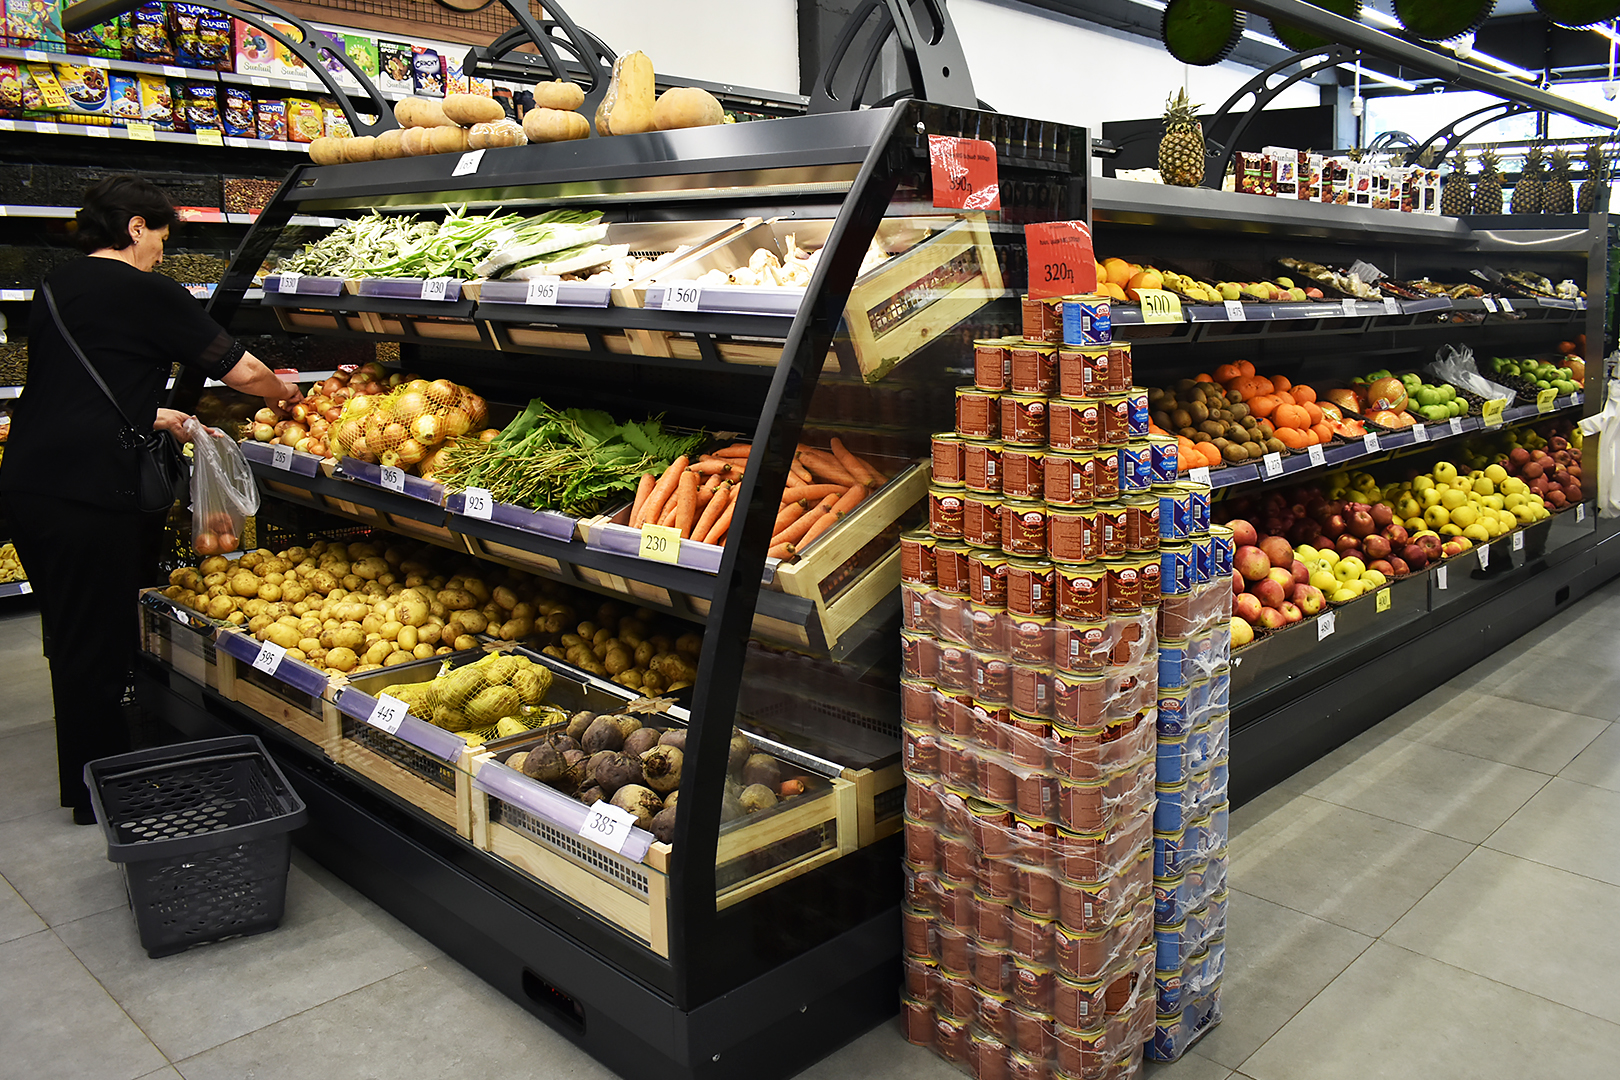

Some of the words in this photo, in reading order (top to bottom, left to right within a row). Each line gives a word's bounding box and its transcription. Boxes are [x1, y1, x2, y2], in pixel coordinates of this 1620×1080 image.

[429, 281, 444, 294] 230
[537, 284, 554, 298] 965
[676, 288, 697, 303] 560
[1144, 295, 1170, 317] 500
[275, 450, 286, 464] 285
[383, 468, 397, 484] 365
[469, 496, 484, 511] 925
[645, 534, 667, 552] 230
[260, 650, 275, 666] 595
[377, 705, 395, 723] 445
[589, 812, 618, 836] 385
